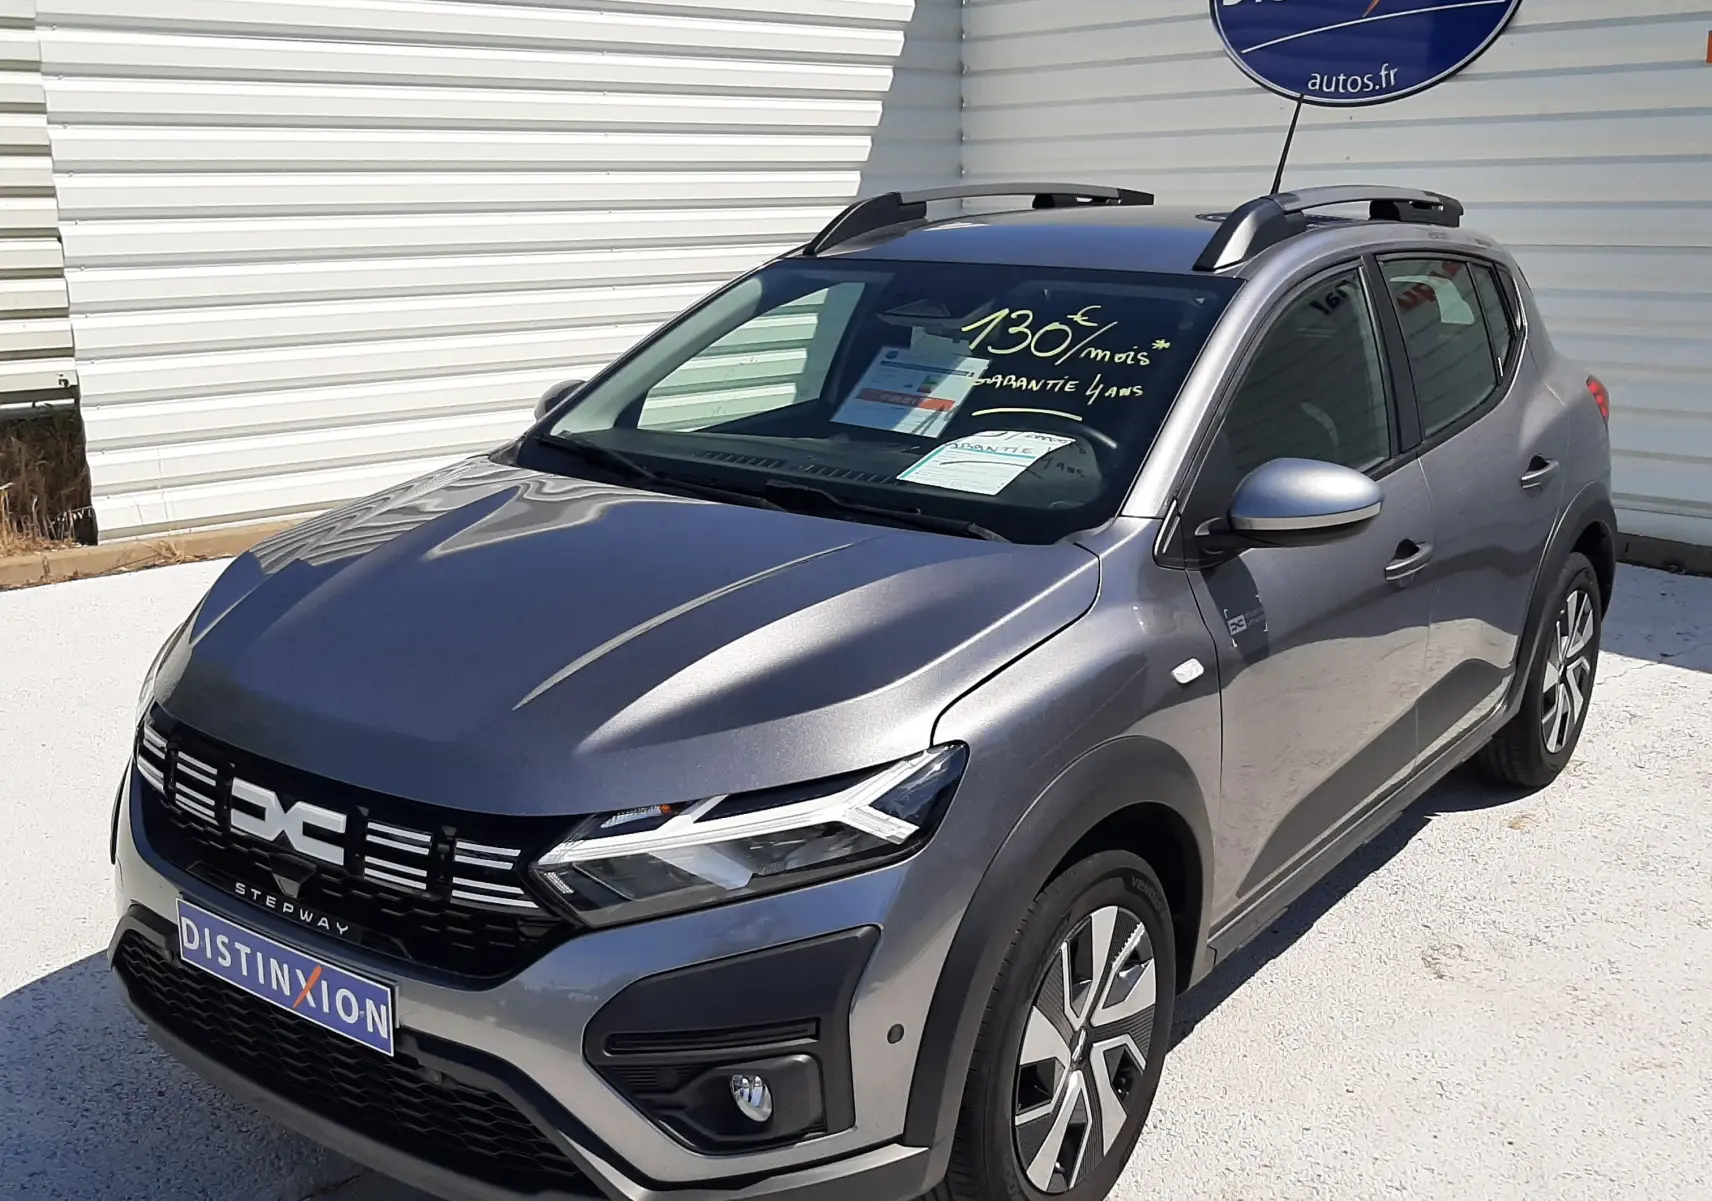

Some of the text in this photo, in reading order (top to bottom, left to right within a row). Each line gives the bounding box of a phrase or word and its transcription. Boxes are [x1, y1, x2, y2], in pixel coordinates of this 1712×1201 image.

[1307, 63, 1398, 93] autos.fr
[1085, 373, 1102, 406] 4
[235, 881, 349, 936] STEPWAY
[180, 915, 389, 1040] DISTINXION
